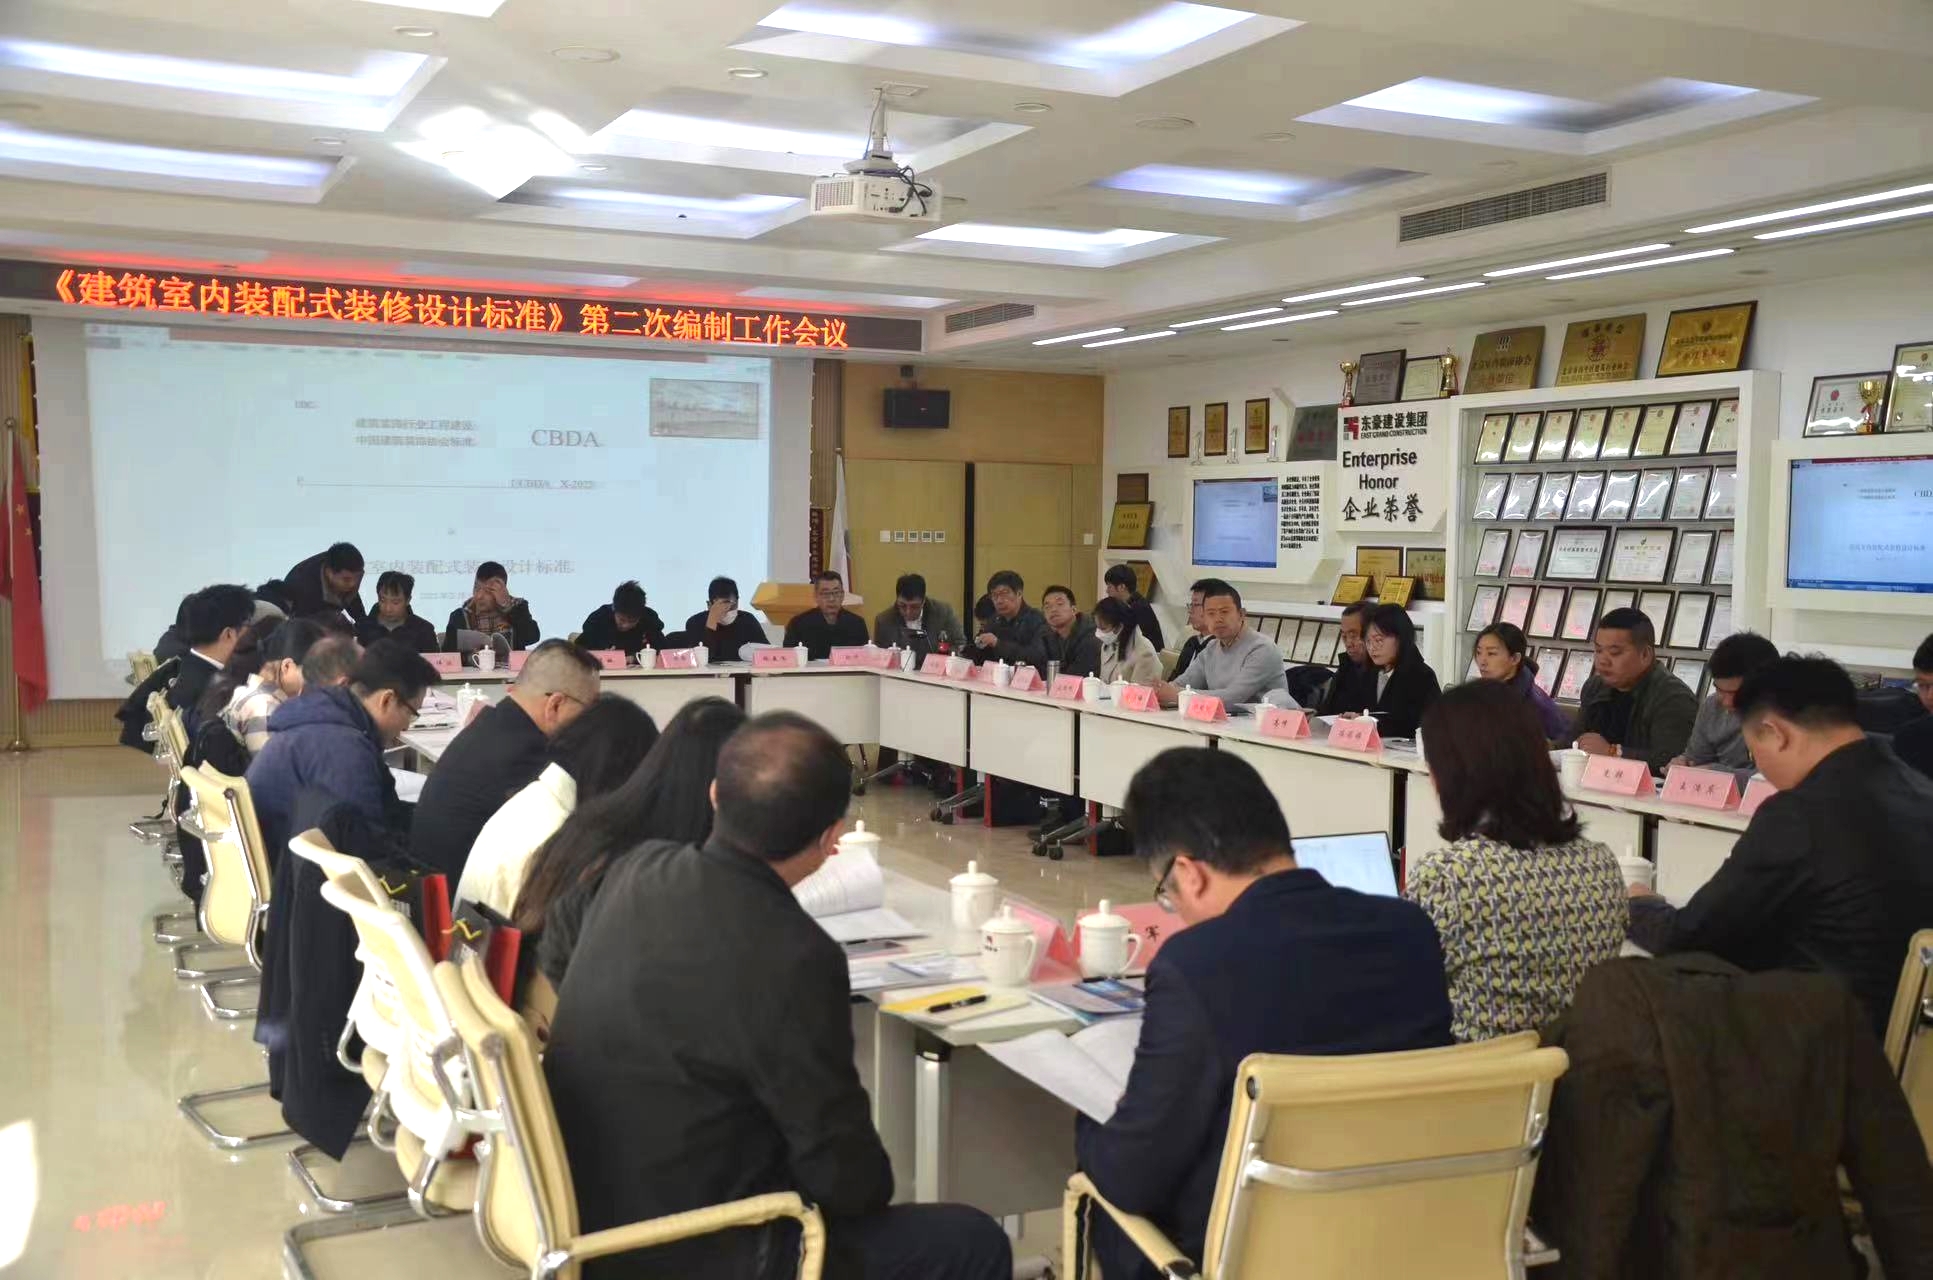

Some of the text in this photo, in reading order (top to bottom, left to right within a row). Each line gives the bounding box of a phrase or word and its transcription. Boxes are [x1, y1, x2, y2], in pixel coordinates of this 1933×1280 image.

[56, 269, 849, 349] 《建筑室内装配式装修设计标准》 第二次编制工作会议
[1361, 411, 1428, 431] 东豪建设集团
[531, 429, 600, 448] CBDA
[1389, 429, 1427, 437] CONSTRUCTION
[1342, 448, 1417, 470] Enterprise
[1359, 474, 1399, 490] Honor
[1342, 493, 1423, 522] 企业荣誉
